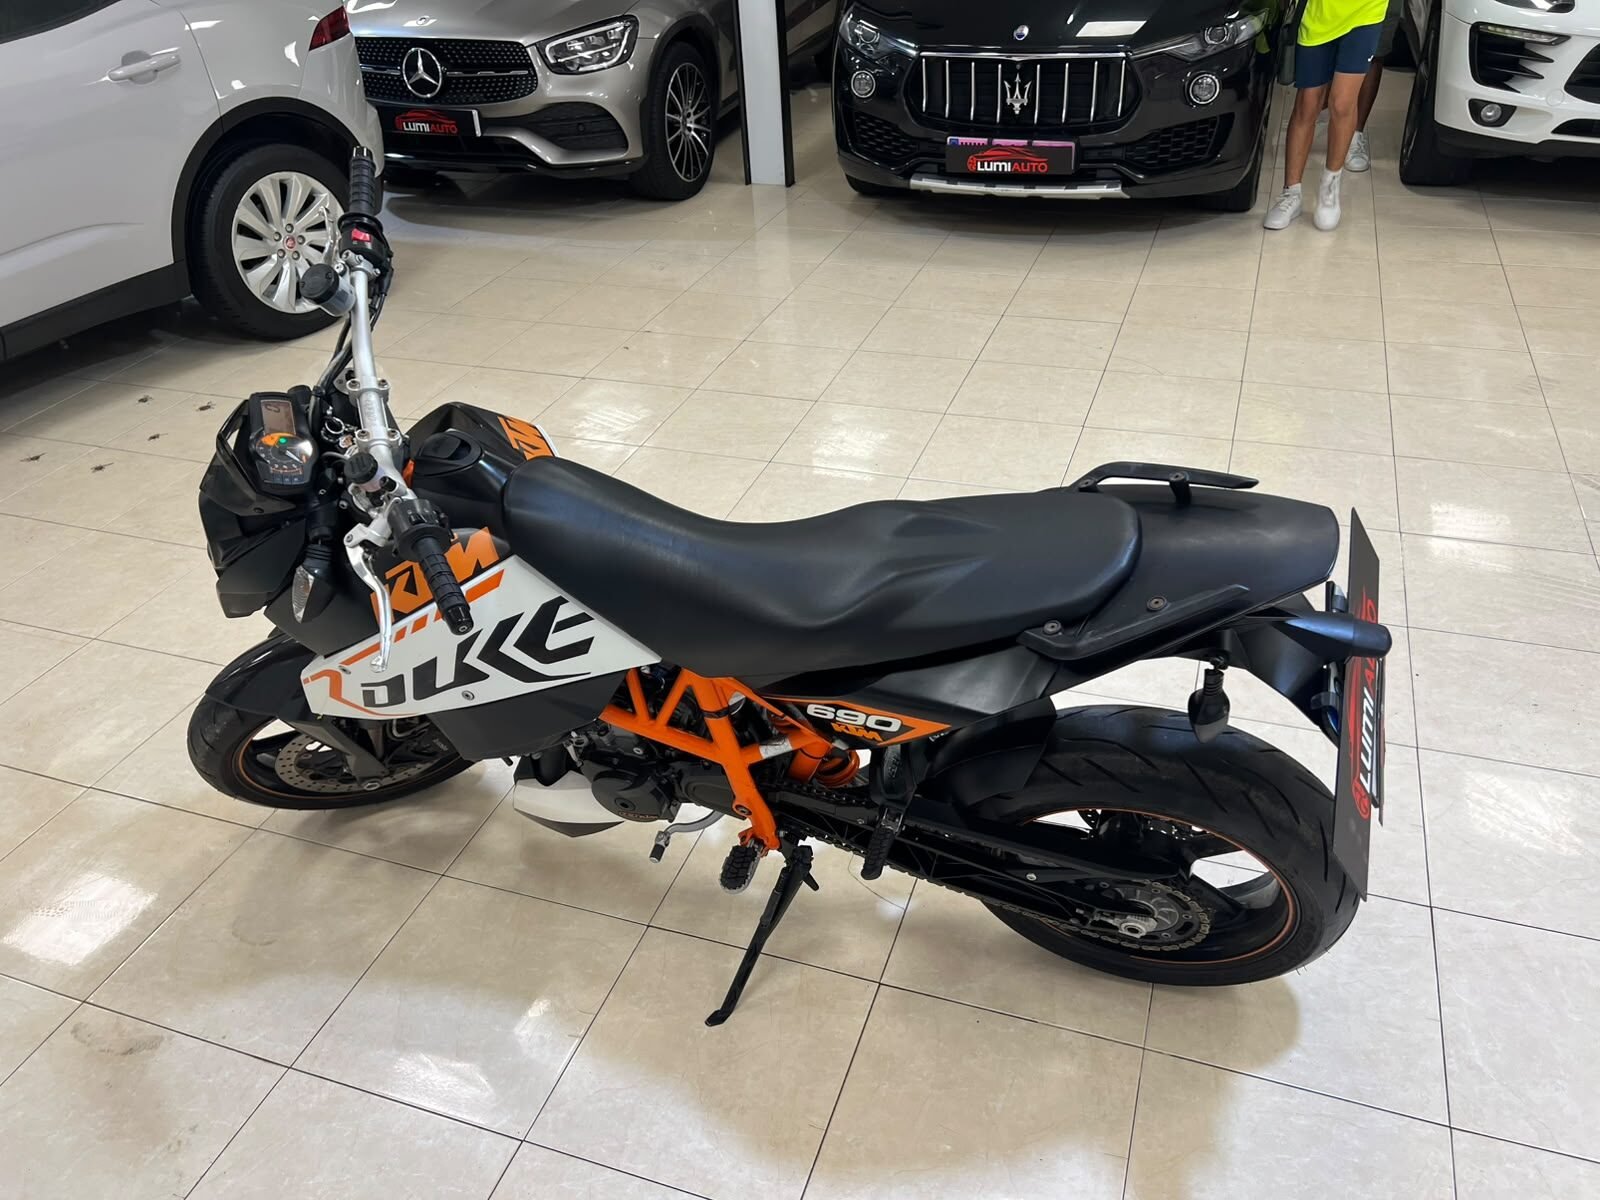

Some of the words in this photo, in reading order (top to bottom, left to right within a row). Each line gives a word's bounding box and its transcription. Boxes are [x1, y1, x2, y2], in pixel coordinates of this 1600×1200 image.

[402, 121, 459, 134] LUMIAUTO
[976, 160, 1049, 173] LUMIAUTO
[360, 595, 595, 708] DUKE
[806, 703, 902, 733] 690
[831, 722, 884, 742] KTM
